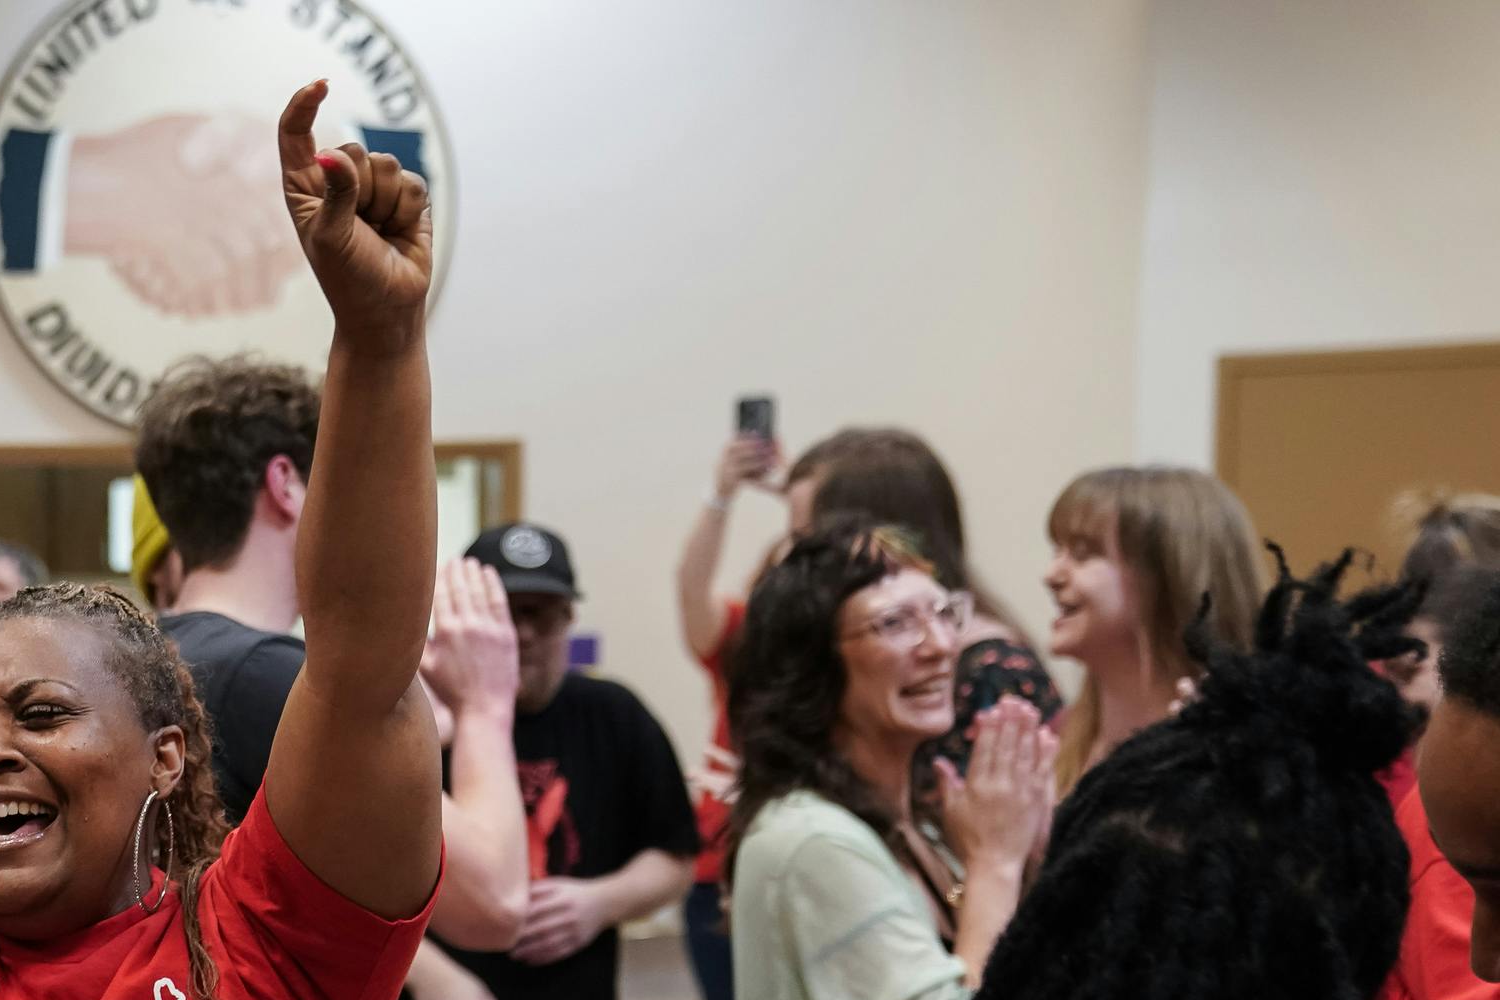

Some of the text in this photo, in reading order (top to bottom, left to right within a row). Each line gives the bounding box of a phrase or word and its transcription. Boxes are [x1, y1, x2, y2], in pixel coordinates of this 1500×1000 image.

[12, 0, 418, 122] UNITED STAND
[25, 302, 152, 408] DIVID
